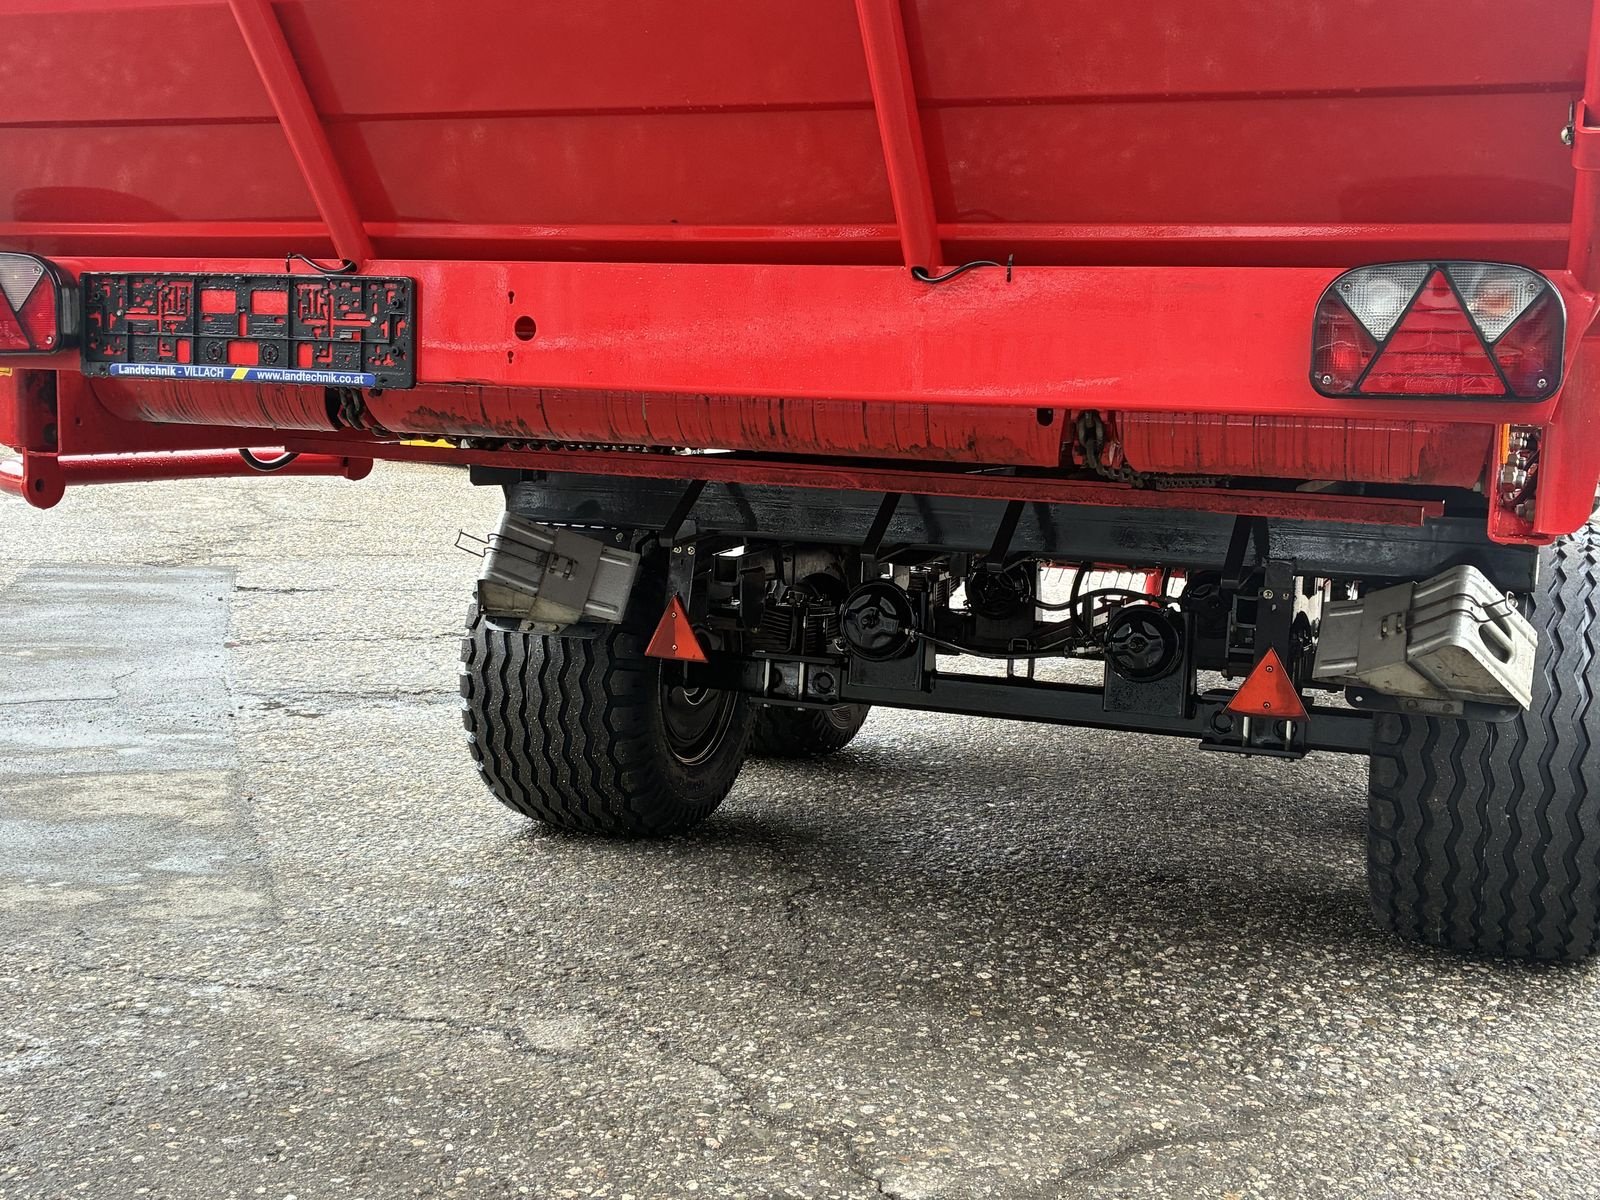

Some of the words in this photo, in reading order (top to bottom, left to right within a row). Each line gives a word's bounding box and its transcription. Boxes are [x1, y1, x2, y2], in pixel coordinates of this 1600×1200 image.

[118, 364, 176, 376] Landtechnik
[184, 367, 224, 378] VILLACH
[256, 371, 364, 384] www.landtechnik.co.at
